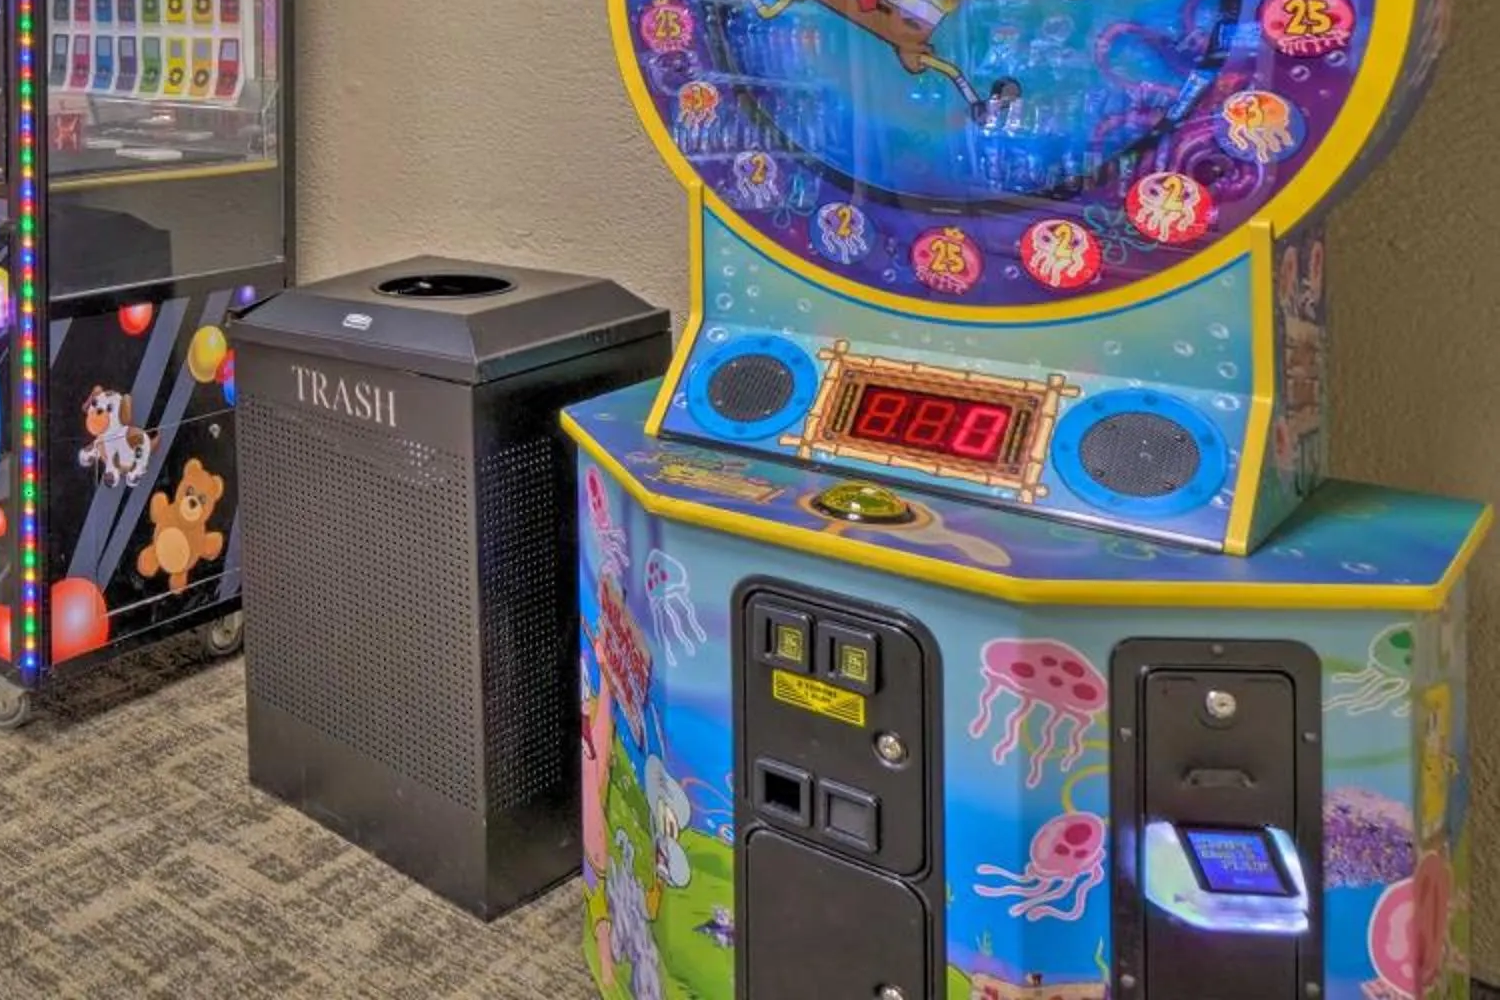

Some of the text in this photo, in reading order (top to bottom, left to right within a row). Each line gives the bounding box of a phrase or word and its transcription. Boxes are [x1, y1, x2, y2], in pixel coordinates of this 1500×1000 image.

[654, 9, 681, 38] 25
[1247, 93, 1265, 129] 3
[751, 154, 766, 185] 2
[1162, 175, 1185, 212] 2
[835, 205, 852, 237] 2
[1053, 220, 1075, 256] 2
[930, 238, 965, 274] 25
[291, 364, 398, 428] TRASH
